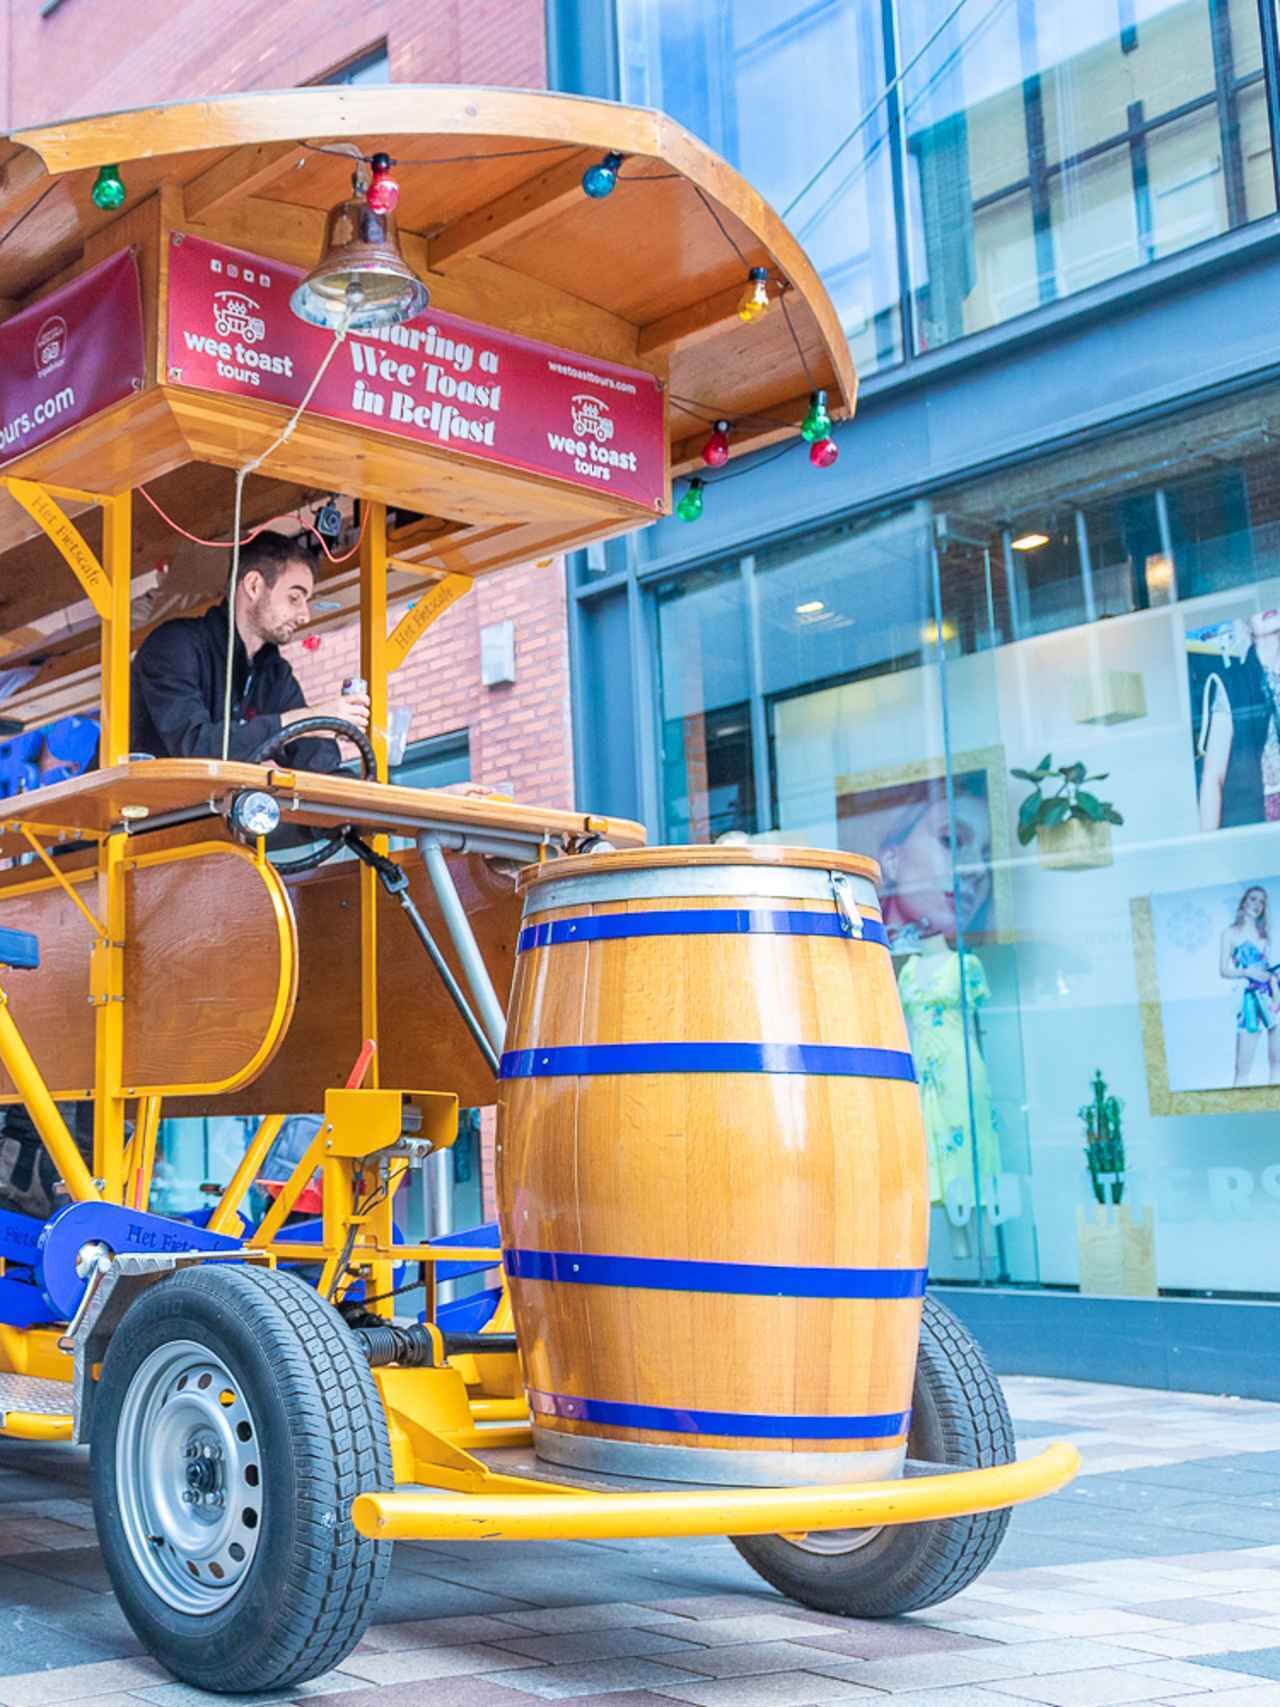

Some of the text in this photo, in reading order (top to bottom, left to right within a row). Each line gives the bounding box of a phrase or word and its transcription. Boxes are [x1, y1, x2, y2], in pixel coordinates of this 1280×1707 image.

[183, 330, 294, 378] wee toast
[349, 325, 499, 374] aring a
[216, 360, 261, 386] tours
[349, 340, 502, 411] Wee Toast
[352, 379, 496, 446] in Belfast
[547, 432, 638, 472] wee toast
[575, 458, 611, 480] tours
[126, 1224, 157, 1249] Het
